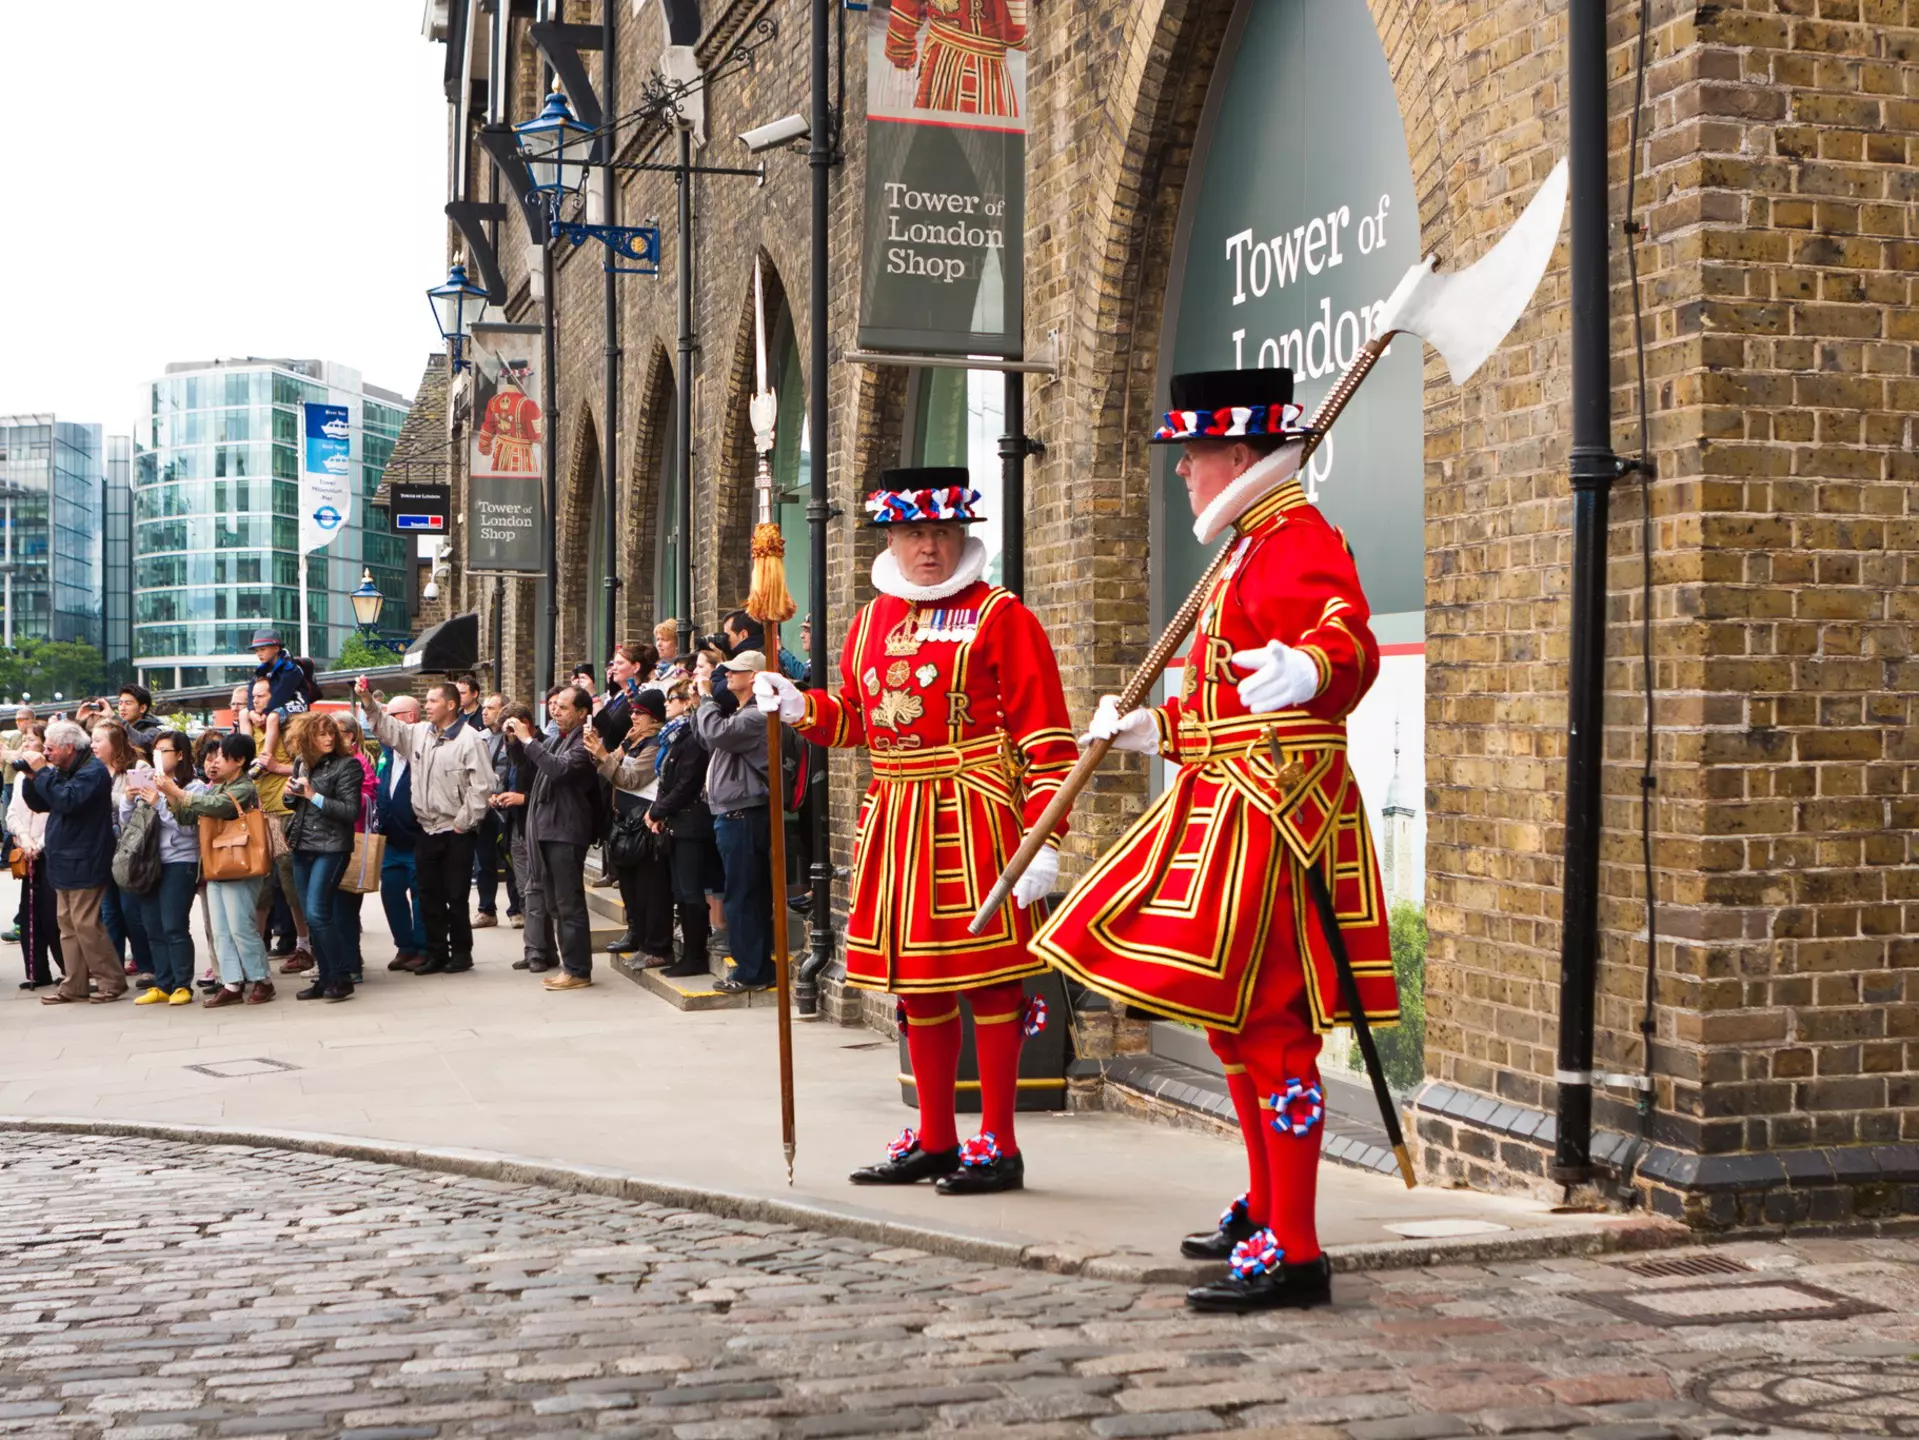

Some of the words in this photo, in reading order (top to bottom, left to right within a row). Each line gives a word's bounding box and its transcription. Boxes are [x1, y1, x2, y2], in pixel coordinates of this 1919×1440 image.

[884, 182, 980, 214] Tower
[984, 200, 1006, 216] of
[888, 216, 1004, 248] London
[887, 248, 965, 283] Shop
[1226, 205, 1349, 306] Tower
[1358, 193, 1390, 255] of
[479, 501, 521, 514] Tower
[523, 506, 533, 514] of
[480, 514, 533, 527] London
[480, 527, 516, 542] Shop
[1206, 637, 1238, 684] R
[945, 691, 975, 725] R
